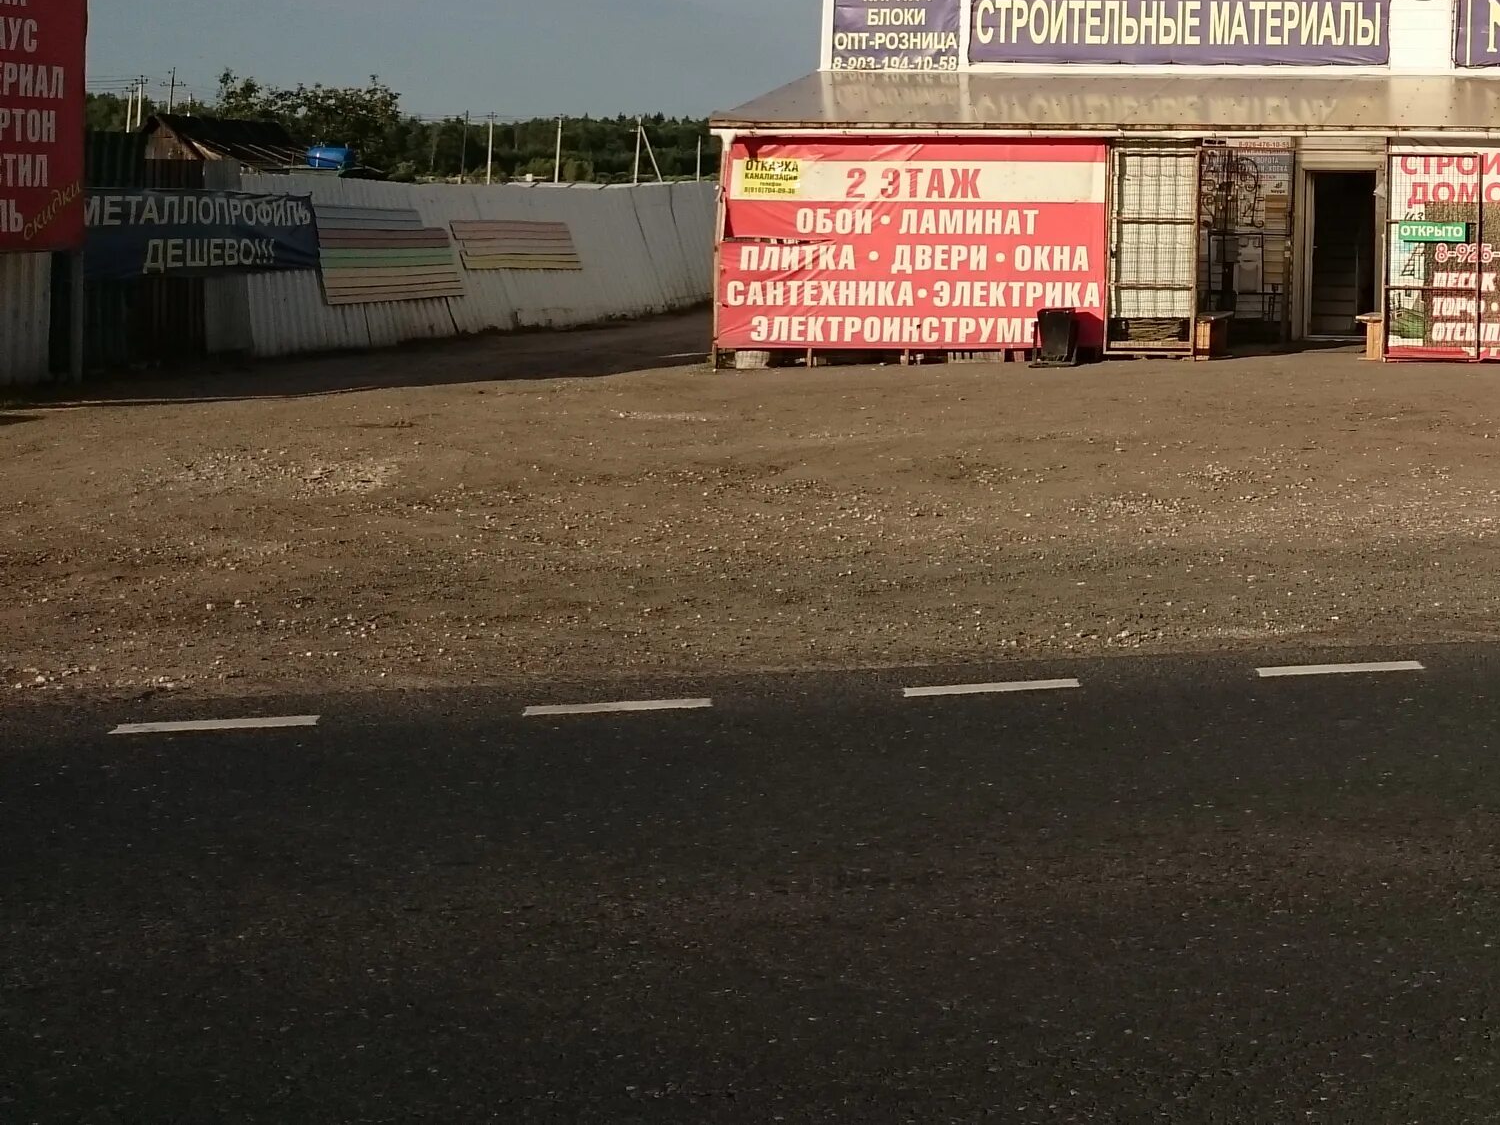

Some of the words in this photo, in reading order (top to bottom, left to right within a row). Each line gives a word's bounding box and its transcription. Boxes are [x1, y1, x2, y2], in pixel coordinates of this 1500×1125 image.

[867, 8, 926, 26] БЛОКИ
[1208, 0, 1380, 47] МАТЕРИАЛЫ
[834, 32, 958, 52] ОПТ-РОЗНИЦА
[832, 56, 957, 70] 8-903-194-10-58
[846, 167, 867, 199] 2
[880, 168, 981, 199] ЭТАЖ
[796, 208, 872, 235] ОБОИ
[898, 208, 1039, 236] ЛАМИНАТ
[1401, 226, 1463, 237] ОТКРЫТО
[143, 238, 275, 274] ДЕШЕВО!!!
[740, 246, 856, 271] ПЛИТКА
[890, 244, 988, 274] ДВЕРИ
[1013, 245, 1089, 271] ОКНА
[727, 280, 914, 307] САНТЕХНИКА
[932, 281, 1100, 308] ЭЛЕКТРИКА
